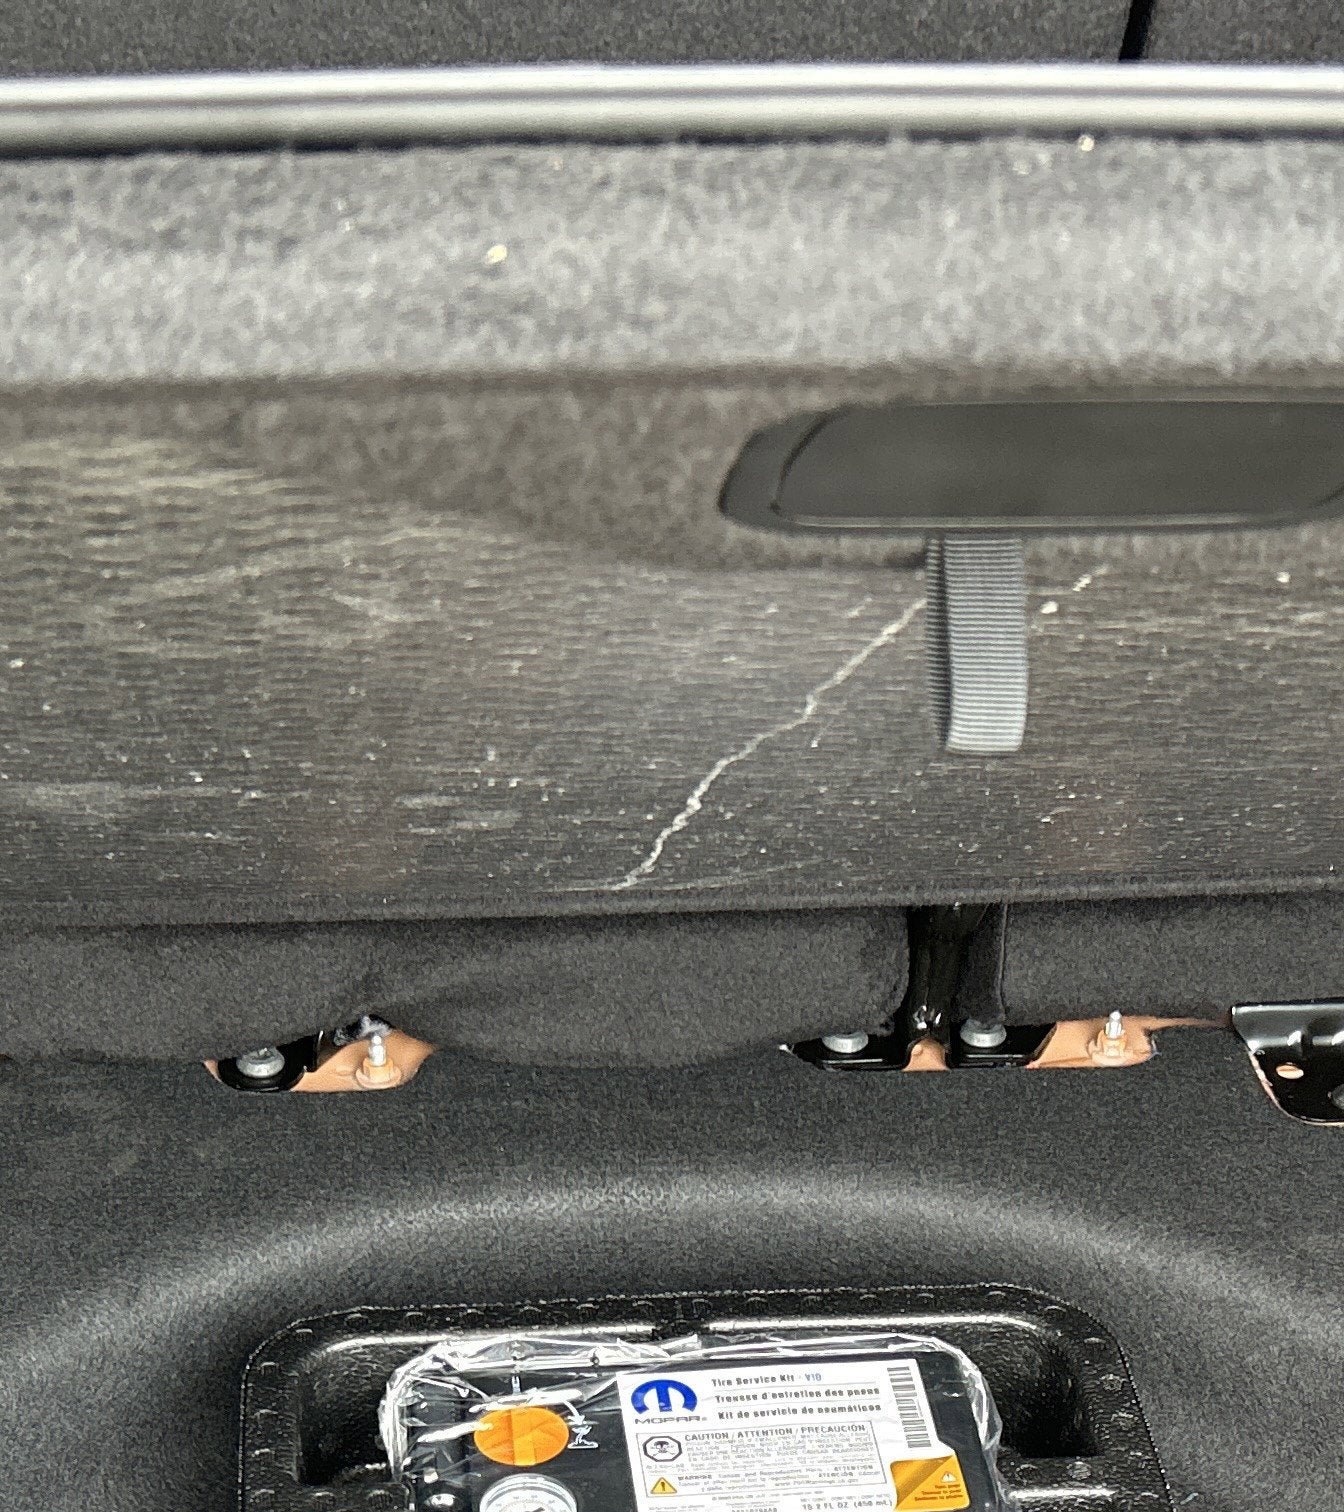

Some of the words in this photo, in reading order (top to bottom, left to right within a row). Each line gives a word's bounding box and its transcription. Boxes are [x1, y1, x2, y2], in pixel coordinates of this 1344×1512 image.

[711, 1378, 733, 1387] Tire
[736, 1375, 777, 1385] Service
[779, 1374, 795, 1382] Kit
[718, 1411, 734, 1420] Kit
[737, 1410, 750, 1419] de
[685, 1432, 729, 1441] CAUTION
[737, 1428, 793, 1438] ATTENTION
